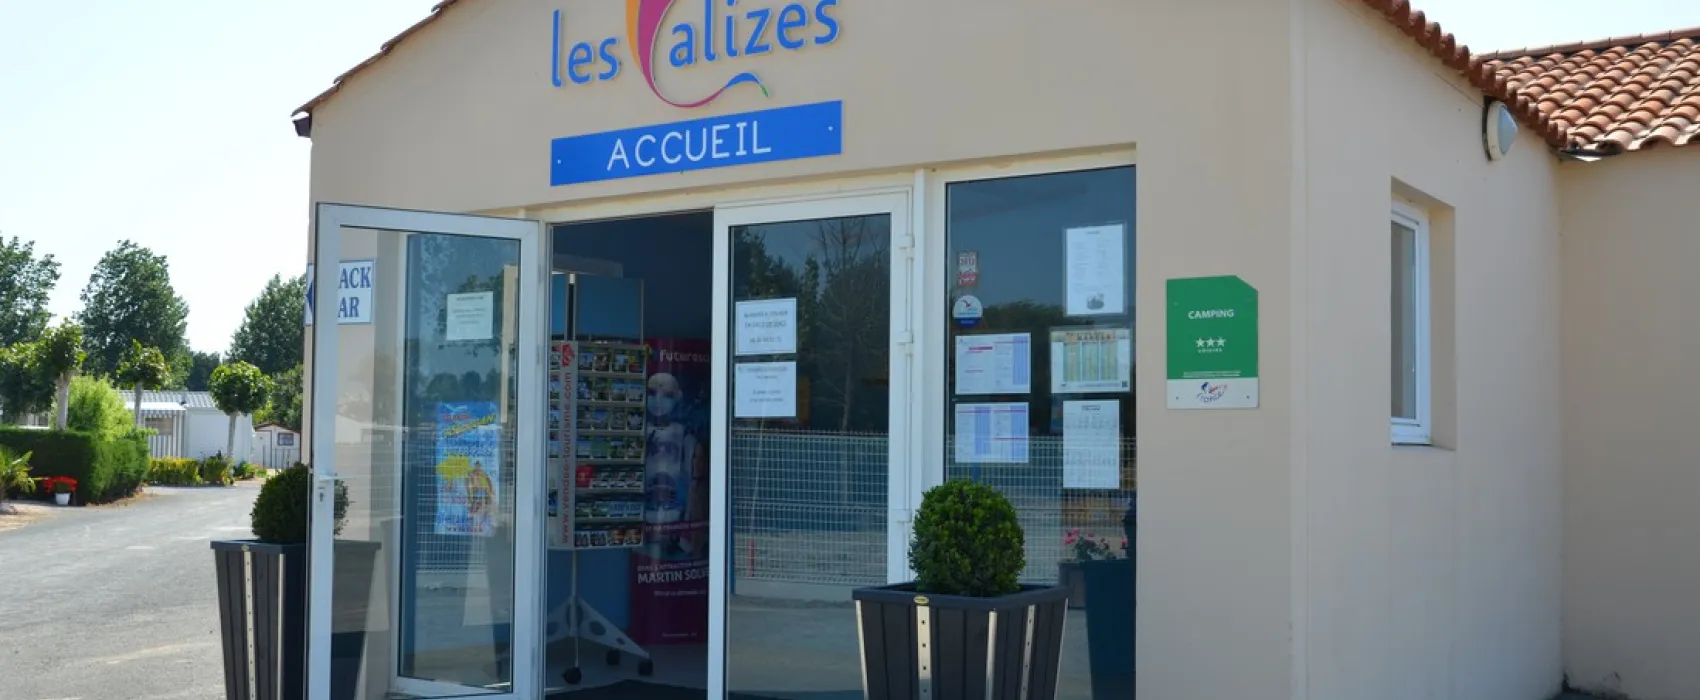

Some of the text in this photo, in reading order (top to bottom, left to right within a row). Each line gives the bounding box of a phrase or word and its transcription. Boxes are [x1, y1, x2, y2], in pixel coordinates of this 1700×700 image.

[551, 8, 621, 89] les
[606, 120, 772, 172] ACCUEIL
[338, 267, 372, 289] ACK
[337, 296, 360, 318] AR
[1187, 308, 1235, 320] CAMPING
[637, 571, 683, 585] MARTIN
